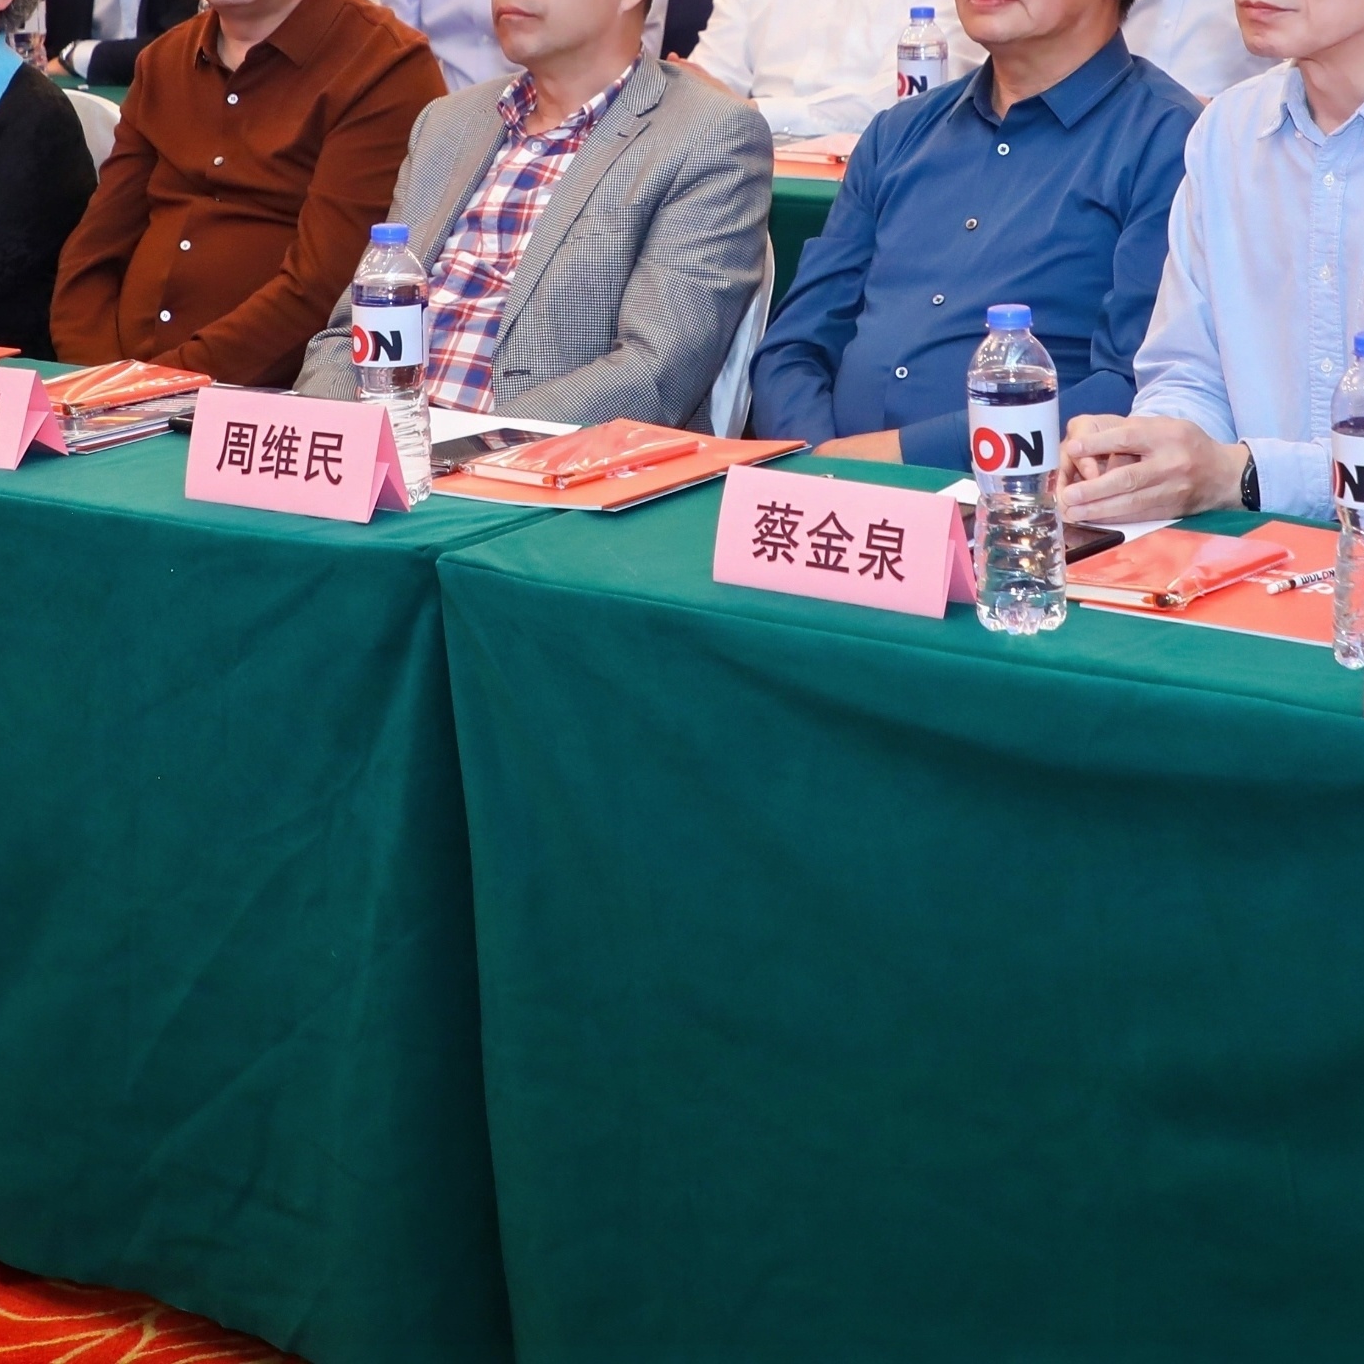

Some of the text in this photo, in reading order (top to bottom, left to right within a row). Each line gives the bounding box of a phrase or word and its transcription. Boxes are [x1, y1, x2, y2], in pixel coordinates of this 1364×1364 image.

[216, 421, 344, 485] 周维民
[752, 500, 906, 582] 蔡金泉
